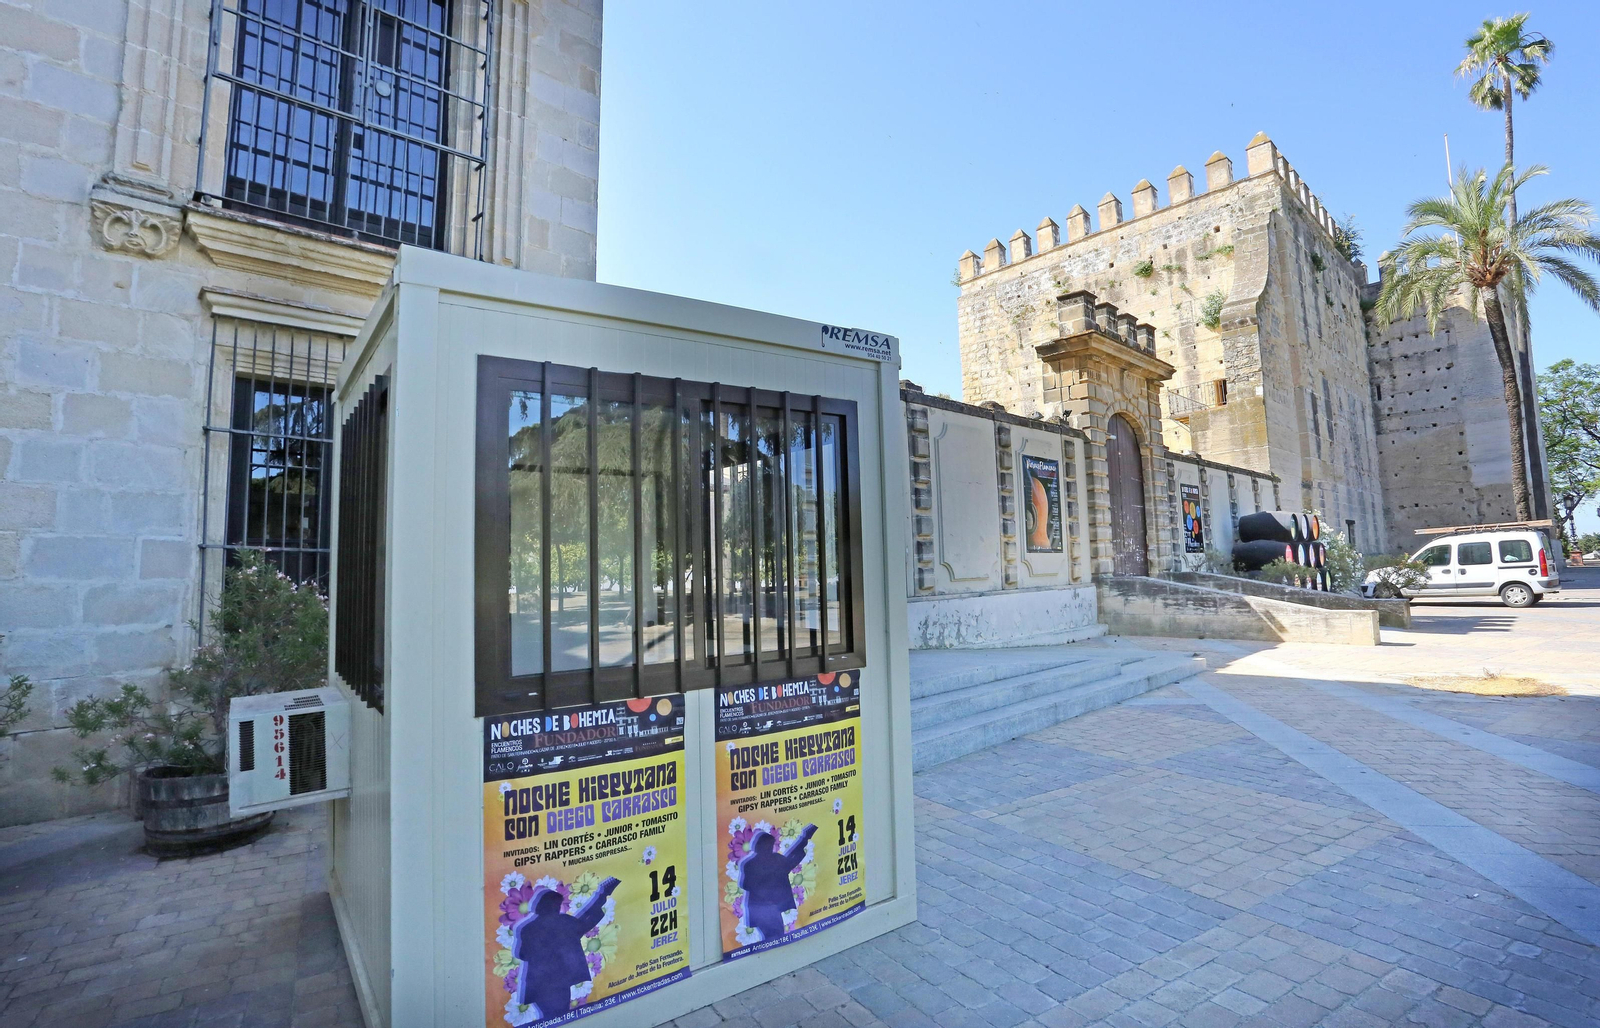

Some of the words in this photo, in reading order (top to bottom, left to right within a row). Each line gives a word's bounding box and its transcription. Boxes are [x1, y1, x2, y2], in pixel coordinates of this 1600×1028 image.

[829, 326, 891, 350] REMSA
[845, 343, 891, 356] www.remsa.net
[720, 689, 755, 707] NOCHES
[758, 687, 769, 700] DE
[772, 681, 809, 699] BOHEMIA
[491, 717, 541, 740] NOCHES
[545, 715, 560, 732] DE
[563, 708, 616, 731] BOHEMIA
[491, 745, 523, 754] FLAMENCOS
[730, 796, 758, 806] INVITADOS:
[760, 791, 771, 800] LIN
[772, 784, 798, 797] CORTÉS
[805, 778, 826, 790] JUNIOR
[831, 769, 857, 783] TOMASITO
[738, 802, 759, 813] GIPSY
[760, 796, 792, 808] RAPPERS
[799, 786, 829, 801] CARRASCO
[830, 780, 849, 792] FAMILY
[778, 804, 798, 813] MUCHAS
[503, 846, 540, 858] INVITADOS:
[544, 840, 559, 851] LIN
[561, 832, 595, 847] CORTÉS
[604, 823, 633, 838] JUNIOR
[641, 812, 679, 828] TOMASITO
[838, 815, 856, 846] 14
[514, 855, 542, 868] GIPSY
[545, 845, 586, 861] RAPPERS
[595, 834, 638, 850] CARRASCO
[640, 824, 667, 839] FAMILY
[838, 842, 856, 857] JULIO
[562, 860, 567, 868] Y
[568, 855, 594, 866] MUCHAS
[838, 852, 858, 875] 22H
[649, 865, 677, 902] 14
[838, 870, 858, 886] JEREZ
[650, 897, 677, 915] JULIO
[650, 909, 678, 937] 22H
[650, 931, 678, 949] JEREZ
[635, 962, 648, 971] Patio
[649, 957, 659, 965] San
[730, 948, 750, 958] ENTRADAS
[635, 968, 649, 978] Jerez
[579, 1002, 604, 1015] Taquilla:
[604, 996, 616, 1006] 23€
[621, 972, 684, 1000] www.tickentradas.com
